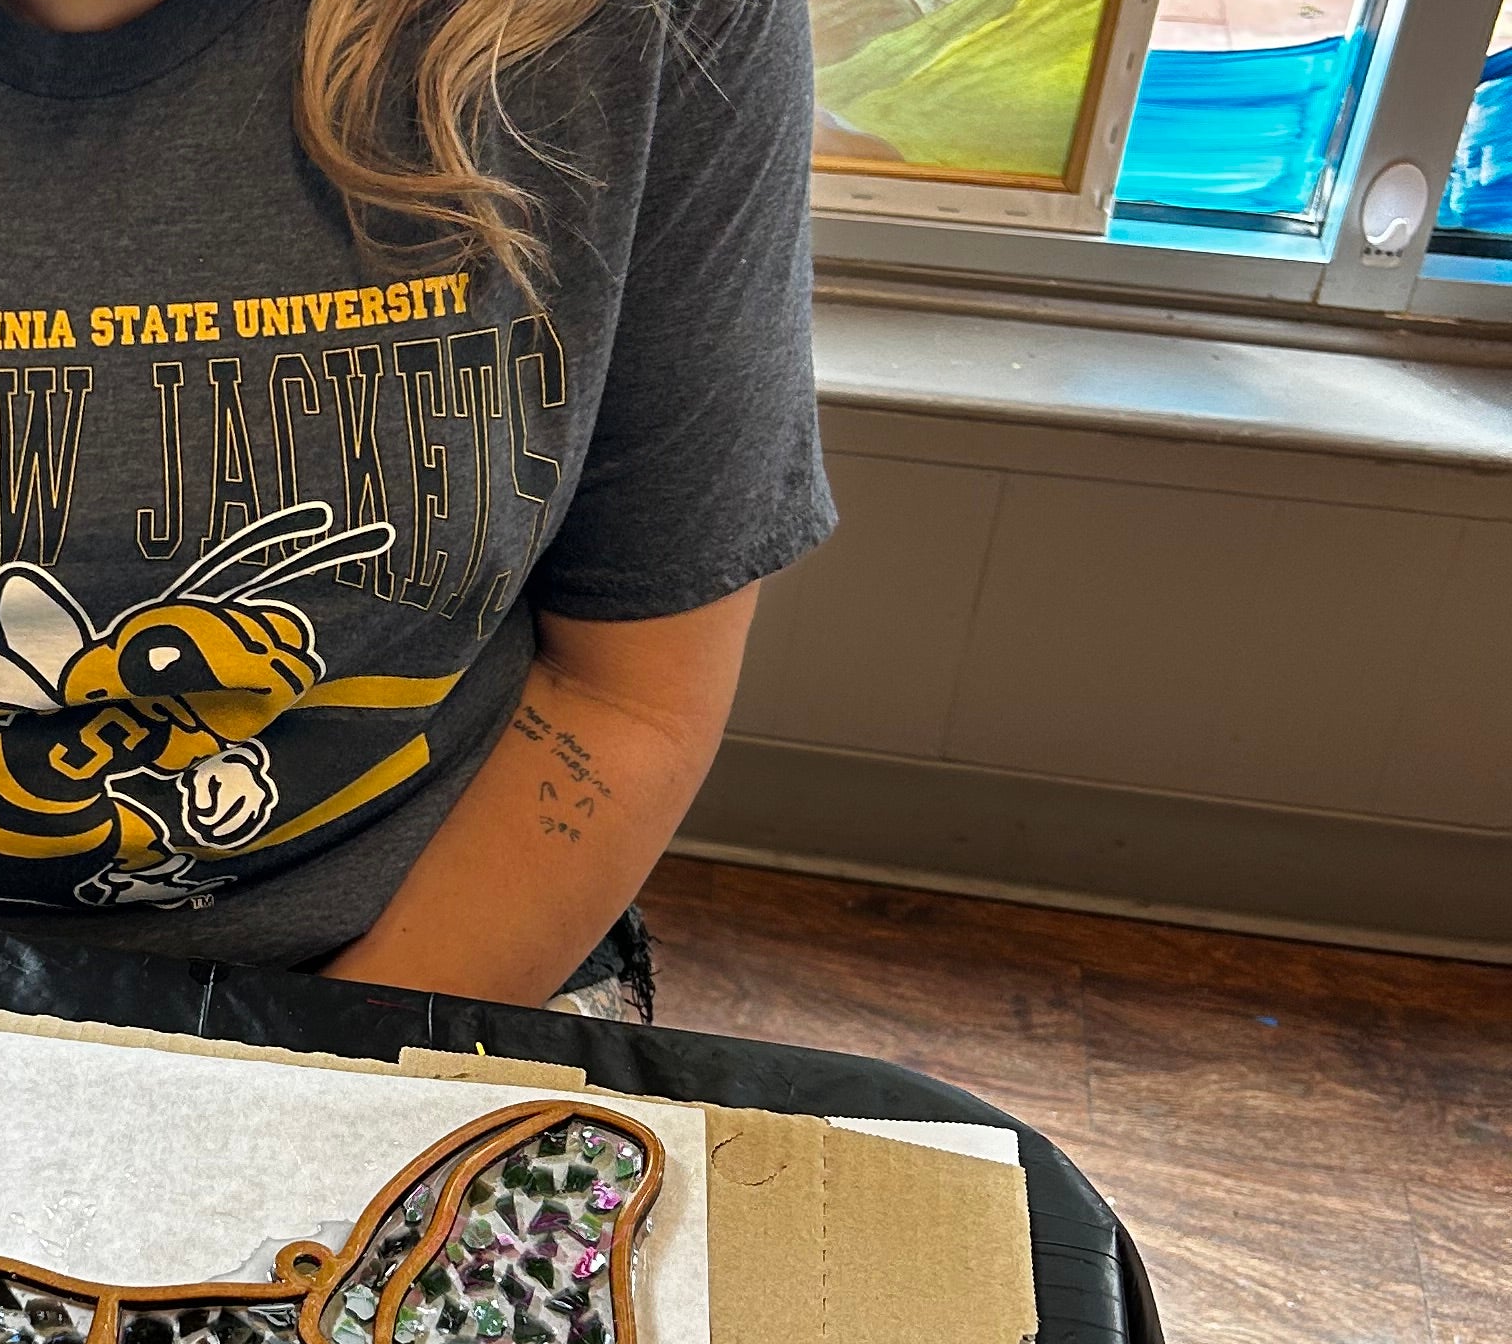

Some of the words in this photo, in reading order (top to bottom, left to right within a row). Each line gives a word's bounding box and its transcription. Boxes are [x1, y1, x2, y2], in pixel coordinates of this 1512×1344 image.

[90, 301, 221, 347] STATE
[233, 272, 470, 338] UNIVERSITY
[136, 313, 567, 641] JACKETS
[49, 707, 150, 780] S
[550, 743, 612, 799] imagine
[555, 731, 591, 761] than
[191, 894, 215, 911] TM
